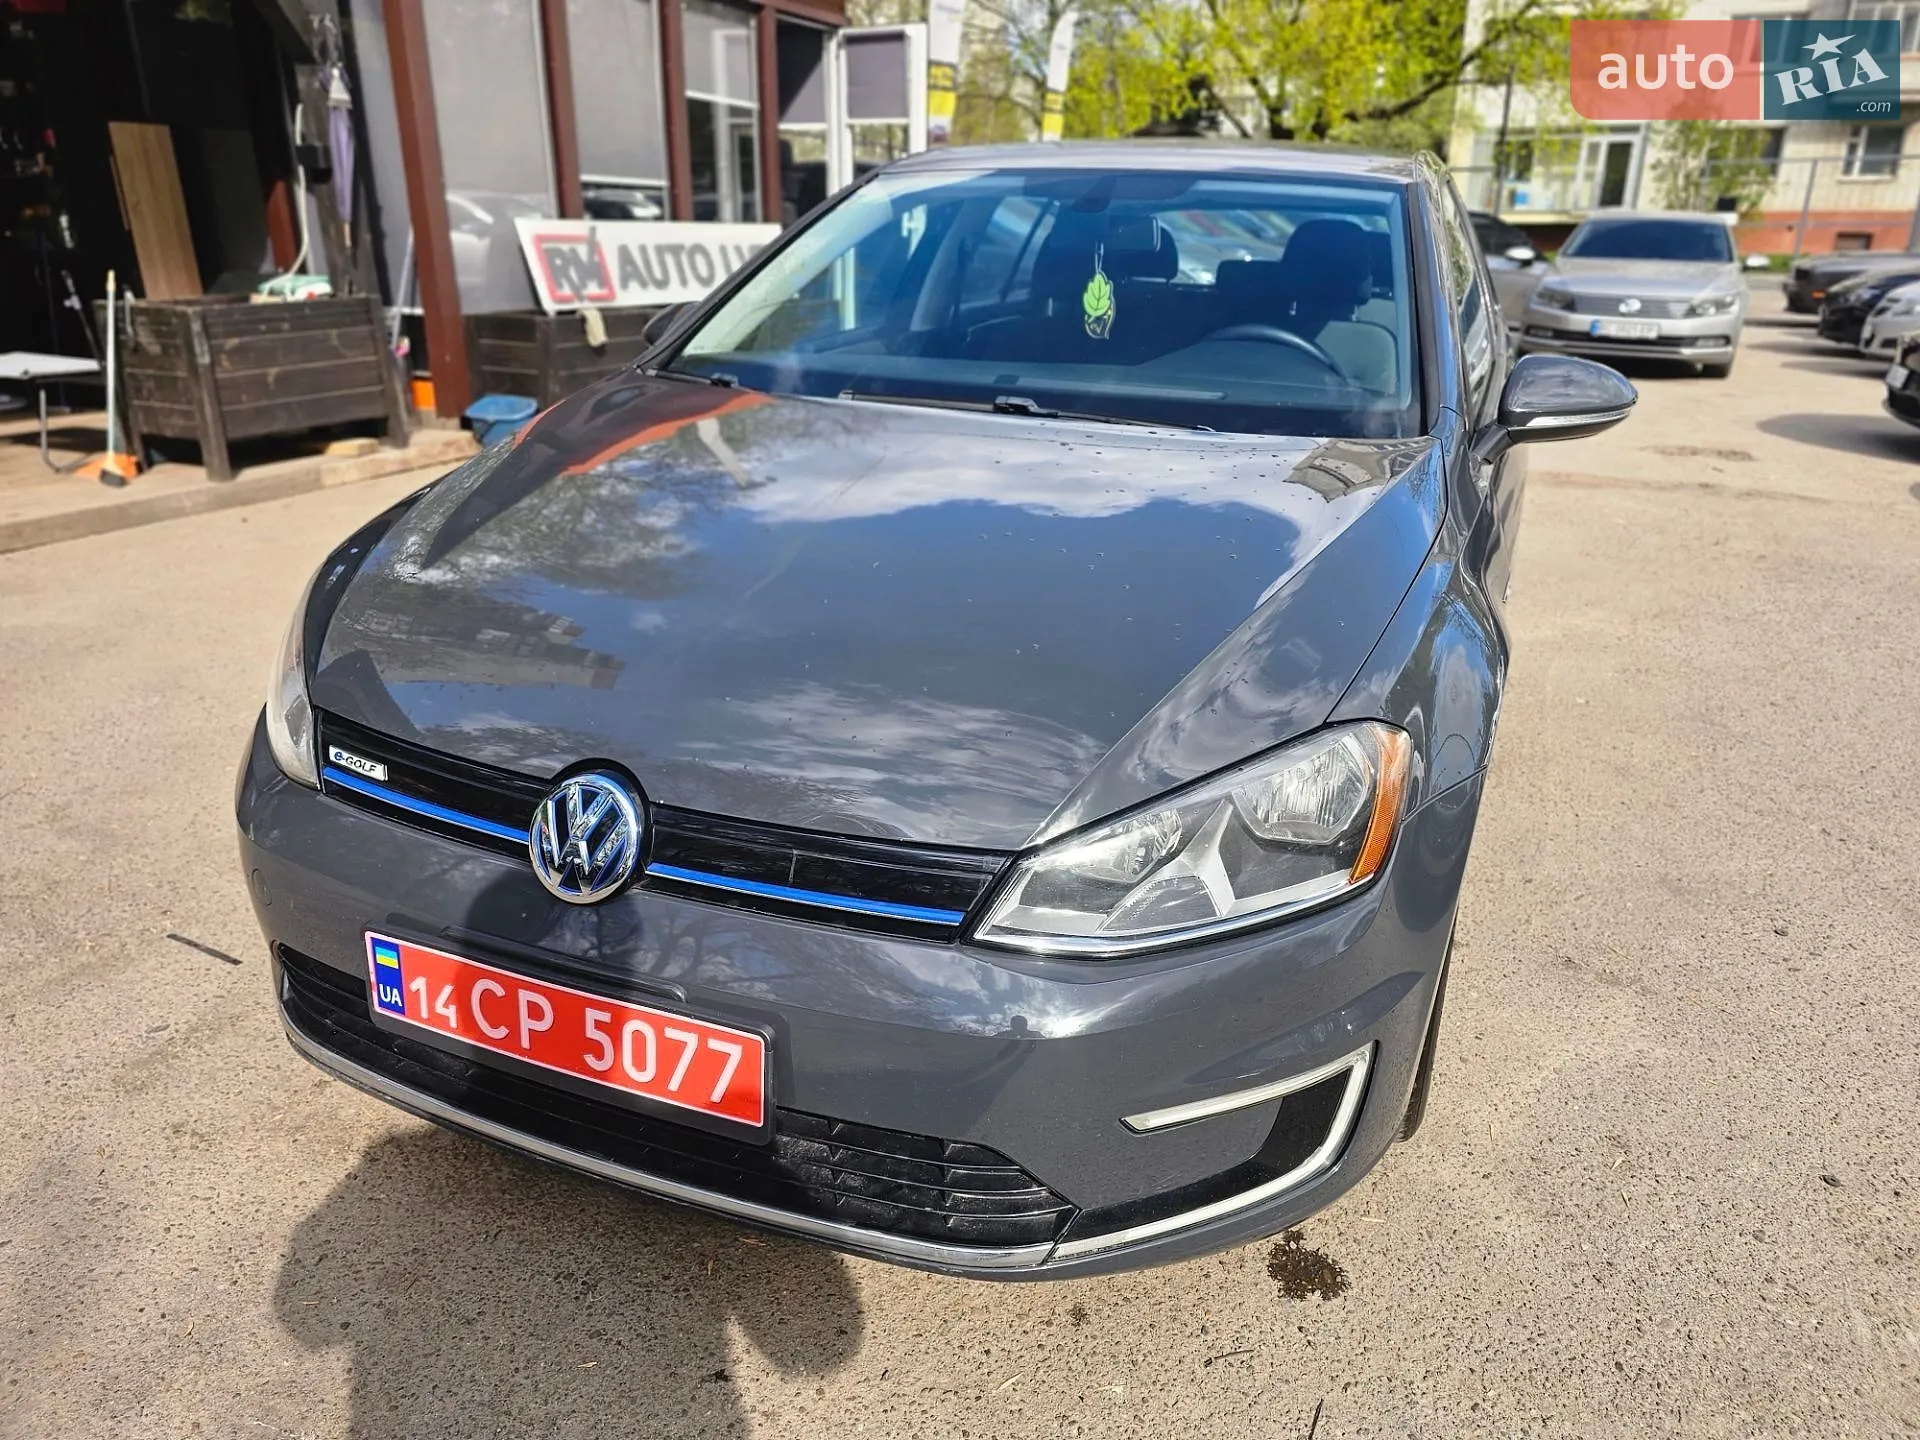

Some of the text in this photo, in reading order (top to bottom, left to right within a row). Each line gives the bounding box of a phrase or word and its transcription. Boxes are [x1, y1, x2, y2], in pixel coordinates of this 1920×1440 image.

[617, 244, 716, 290] AUTO
[334, 751, 377, 773] e-GOLF
[379, 984, 403, 1007] UA
[409, 976, 743, 1104] 14 CP 5077
